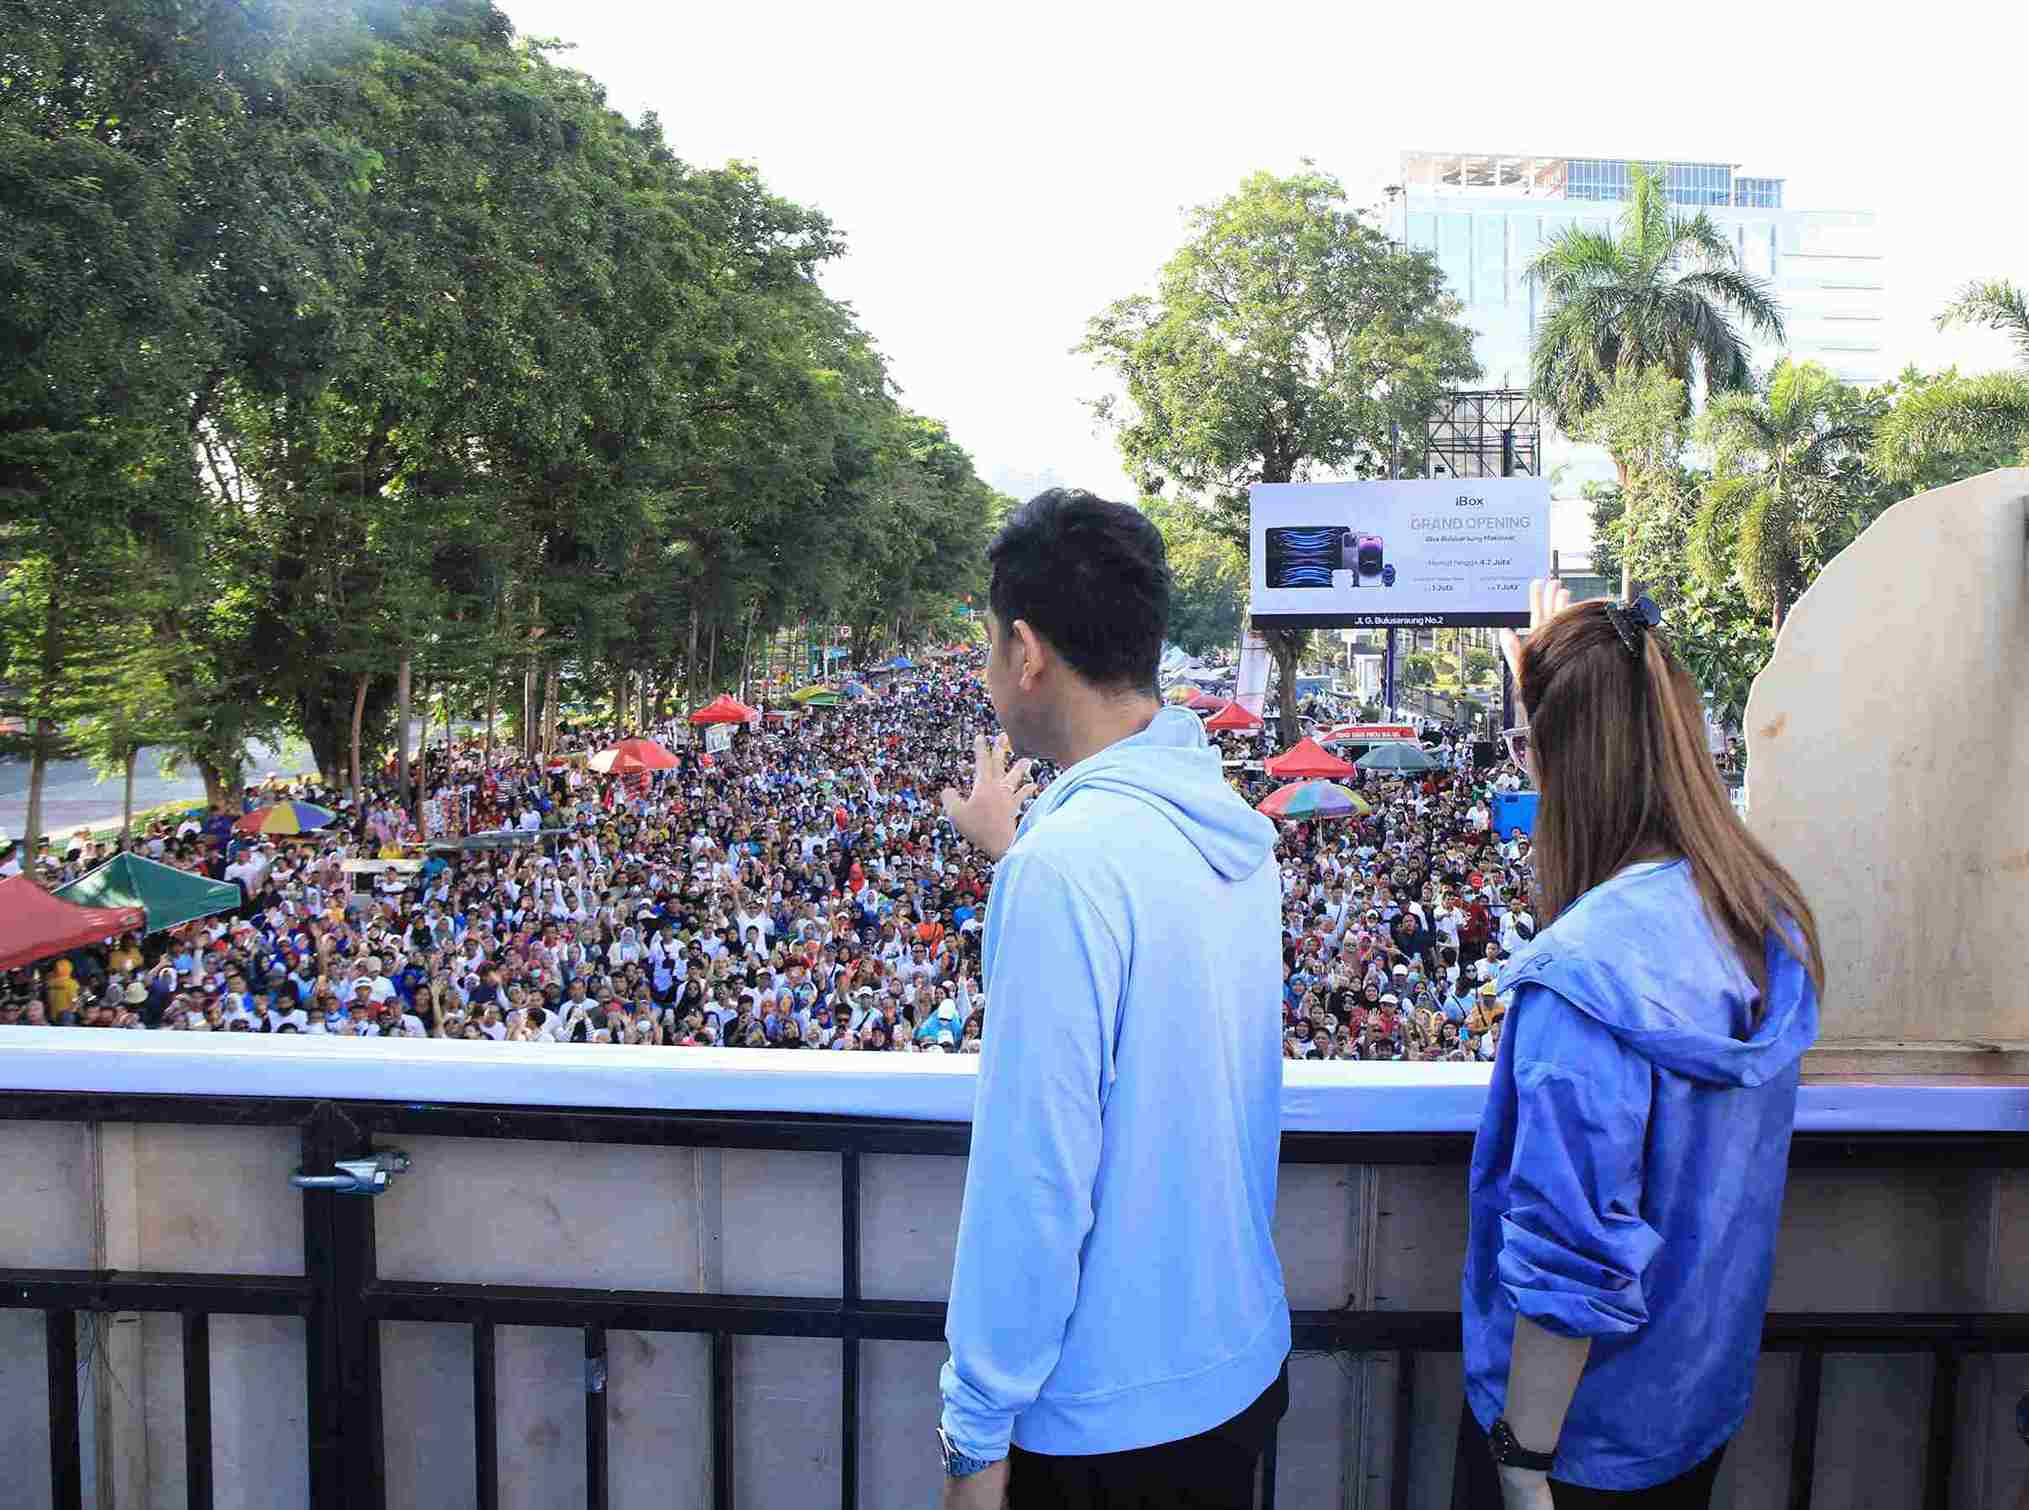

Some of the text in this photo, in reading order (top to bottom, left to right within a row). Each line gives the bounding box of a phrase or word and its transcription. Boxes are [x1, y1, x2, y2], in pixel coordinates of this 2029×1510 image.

[1455, 495, 1484, 506] iBox
[1410, 515, 1531, 530] GRAND OPENING
[1424, 615, 1444, 625] No.2
